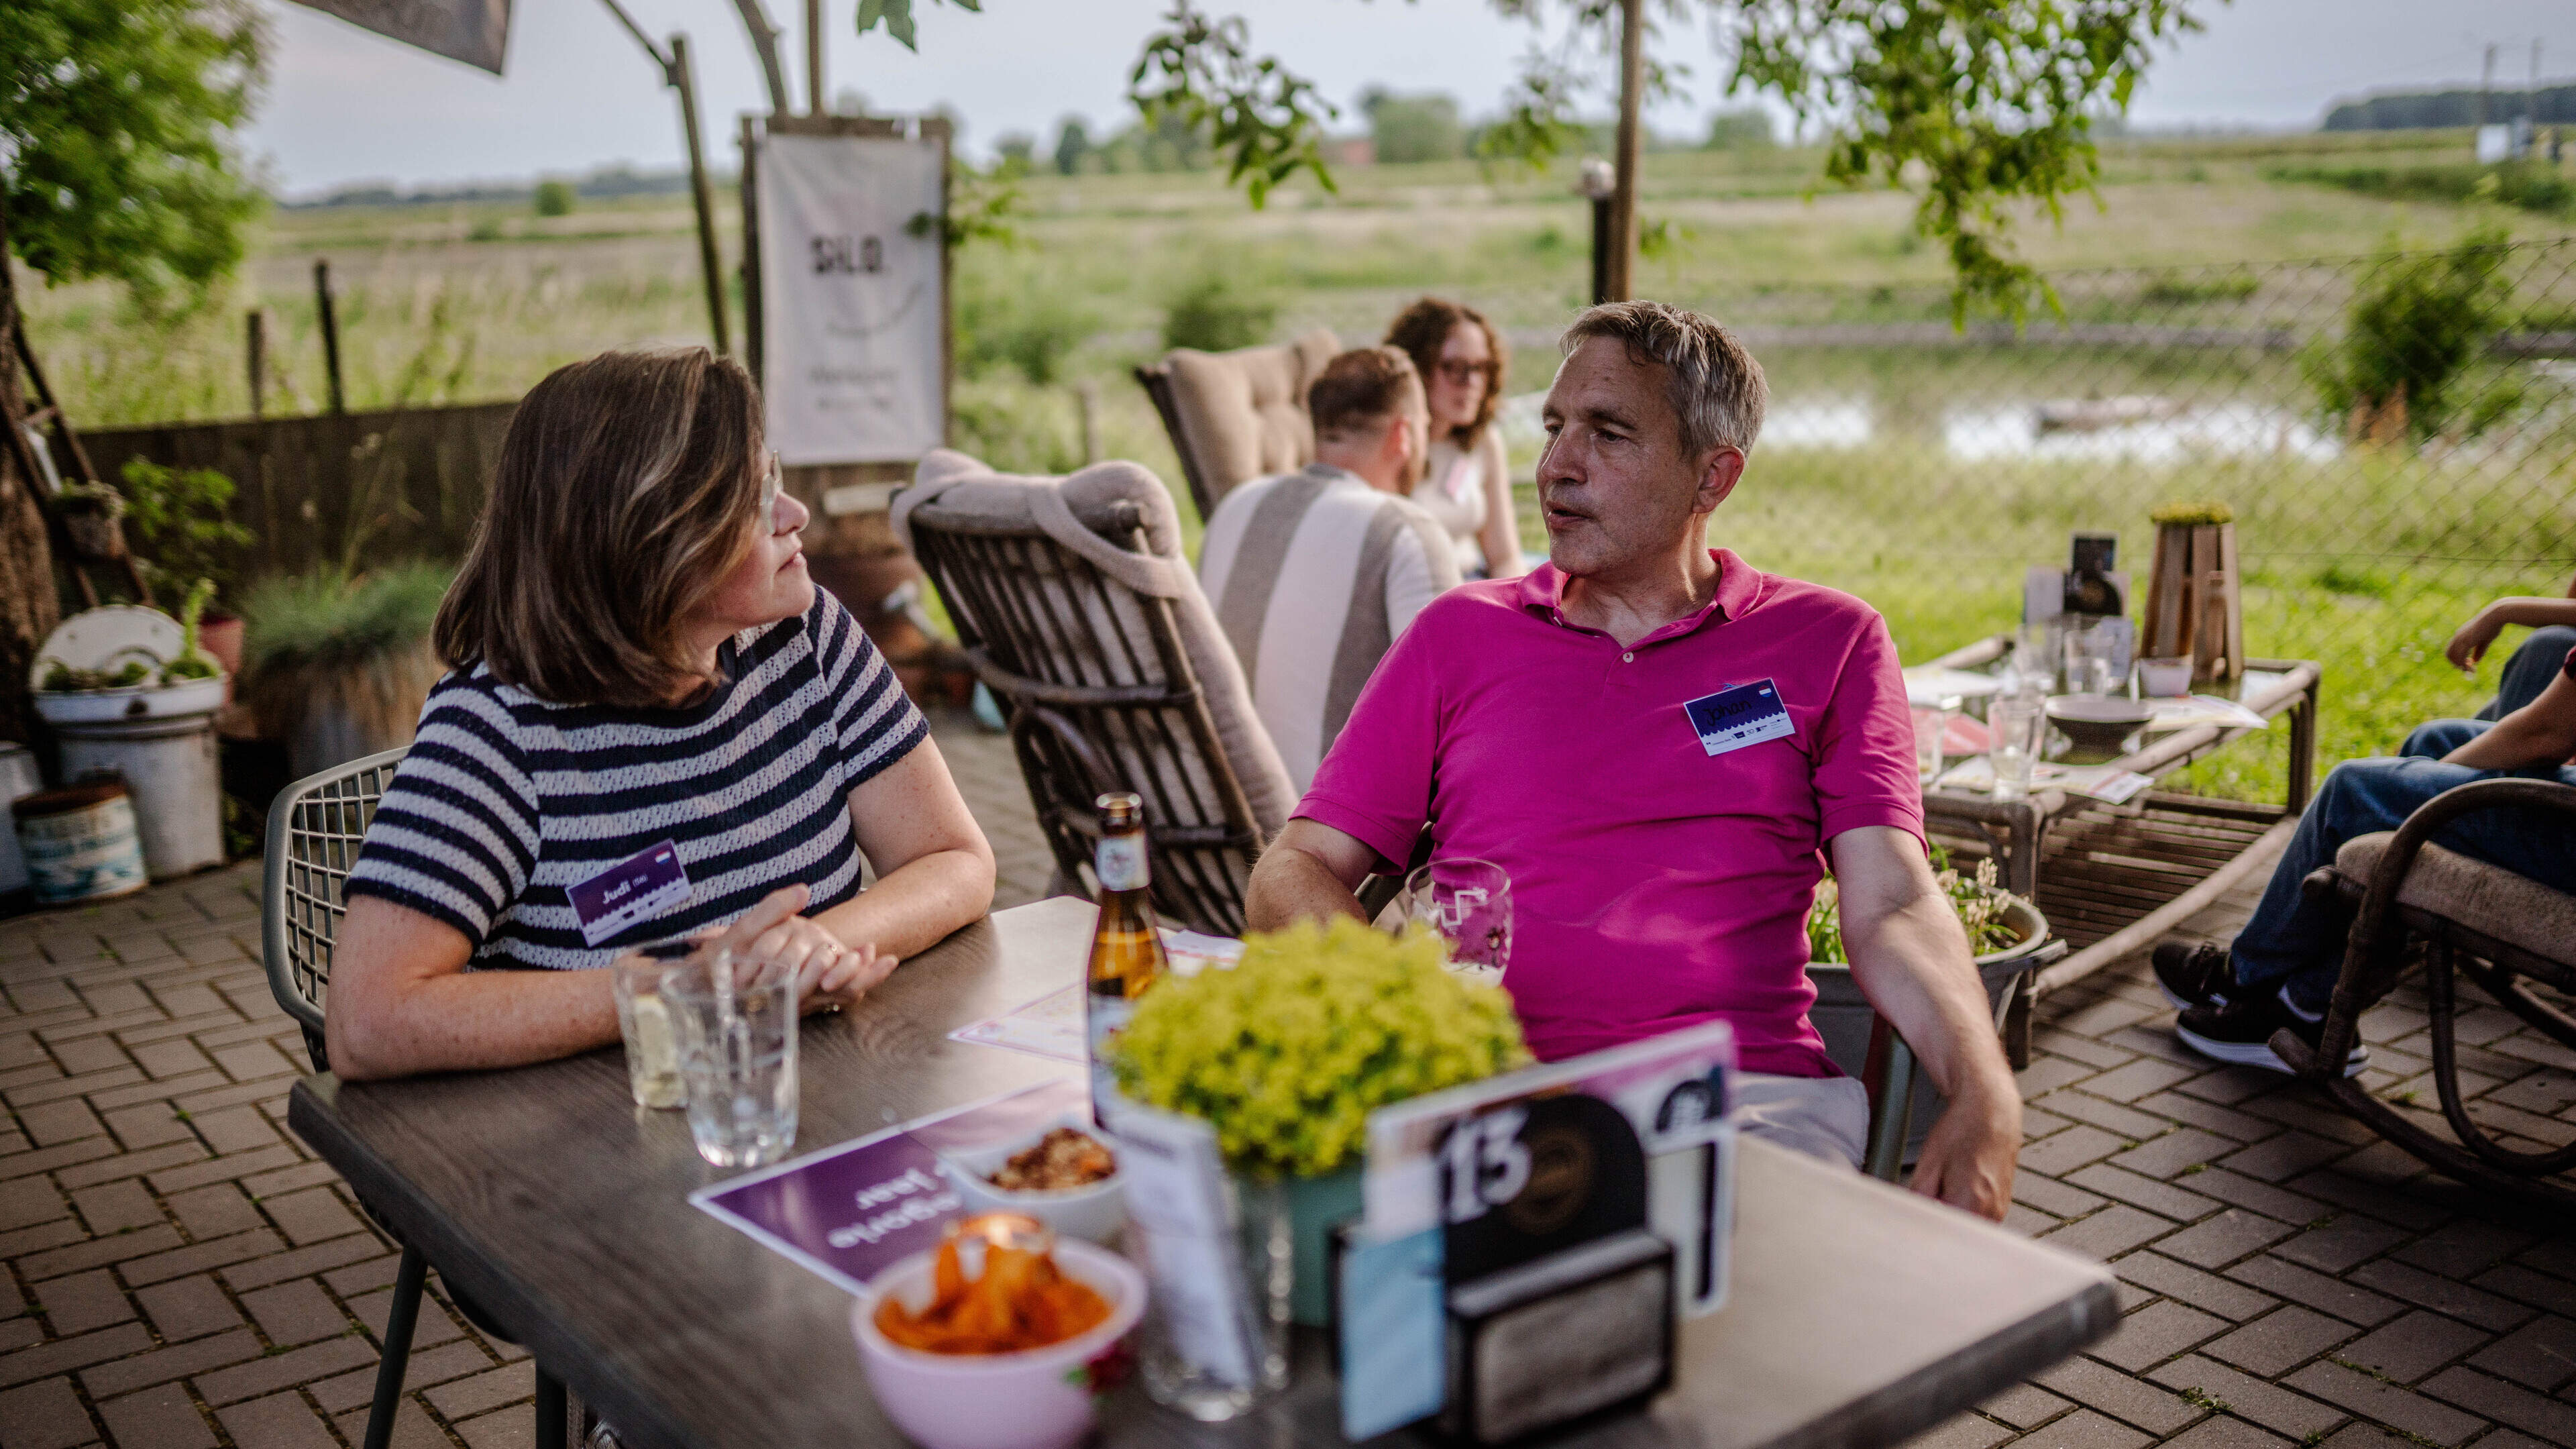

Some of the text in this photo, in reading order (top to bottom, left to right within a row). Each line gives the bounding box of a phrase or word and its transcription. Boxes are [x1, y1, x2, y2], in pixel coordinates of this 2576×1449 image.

[1703, 700, 1752, 727] Johan
[602, 879, 631, 905] Judi
[1435, 1106, 1533, 1225] 13
